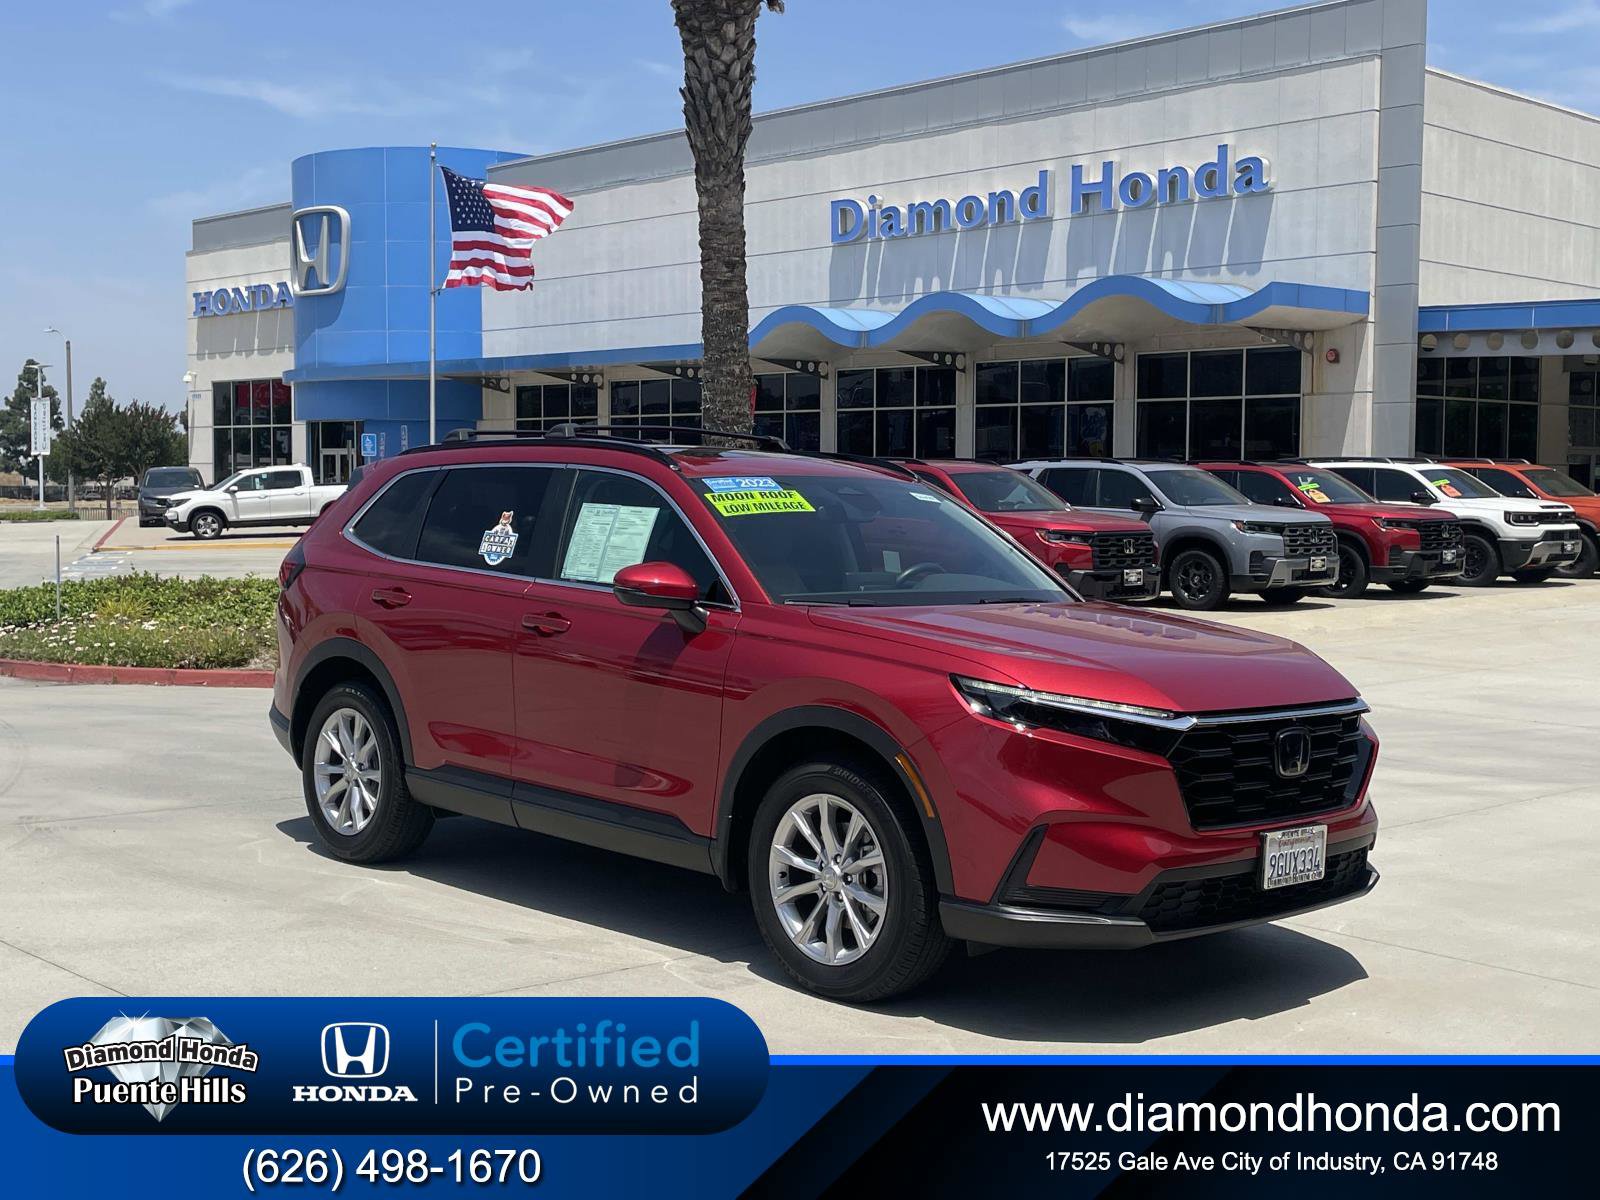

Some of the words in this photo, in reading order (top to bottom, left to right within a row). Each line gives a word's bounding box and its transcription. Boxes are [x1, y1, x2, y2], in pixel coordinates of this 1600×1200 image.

[830, 169, 1054, 245] Diamond
[1071, 144, 1272, 215] Honda
[193, 281, 294, 317] HONDA
[738, 479, 777, 488] 2023
[710, 491, 755, 503] MOON
[759, 489, 795, 500] ROOF
[723, 503, 751, 514] LOW
[753, 501, 808, 512] MILEAGE
[485, 535, 515, 547] CARFAX
[487, 545, 512, 554] OWNER
[1269, 847, 1320, 878] 9GUX334
